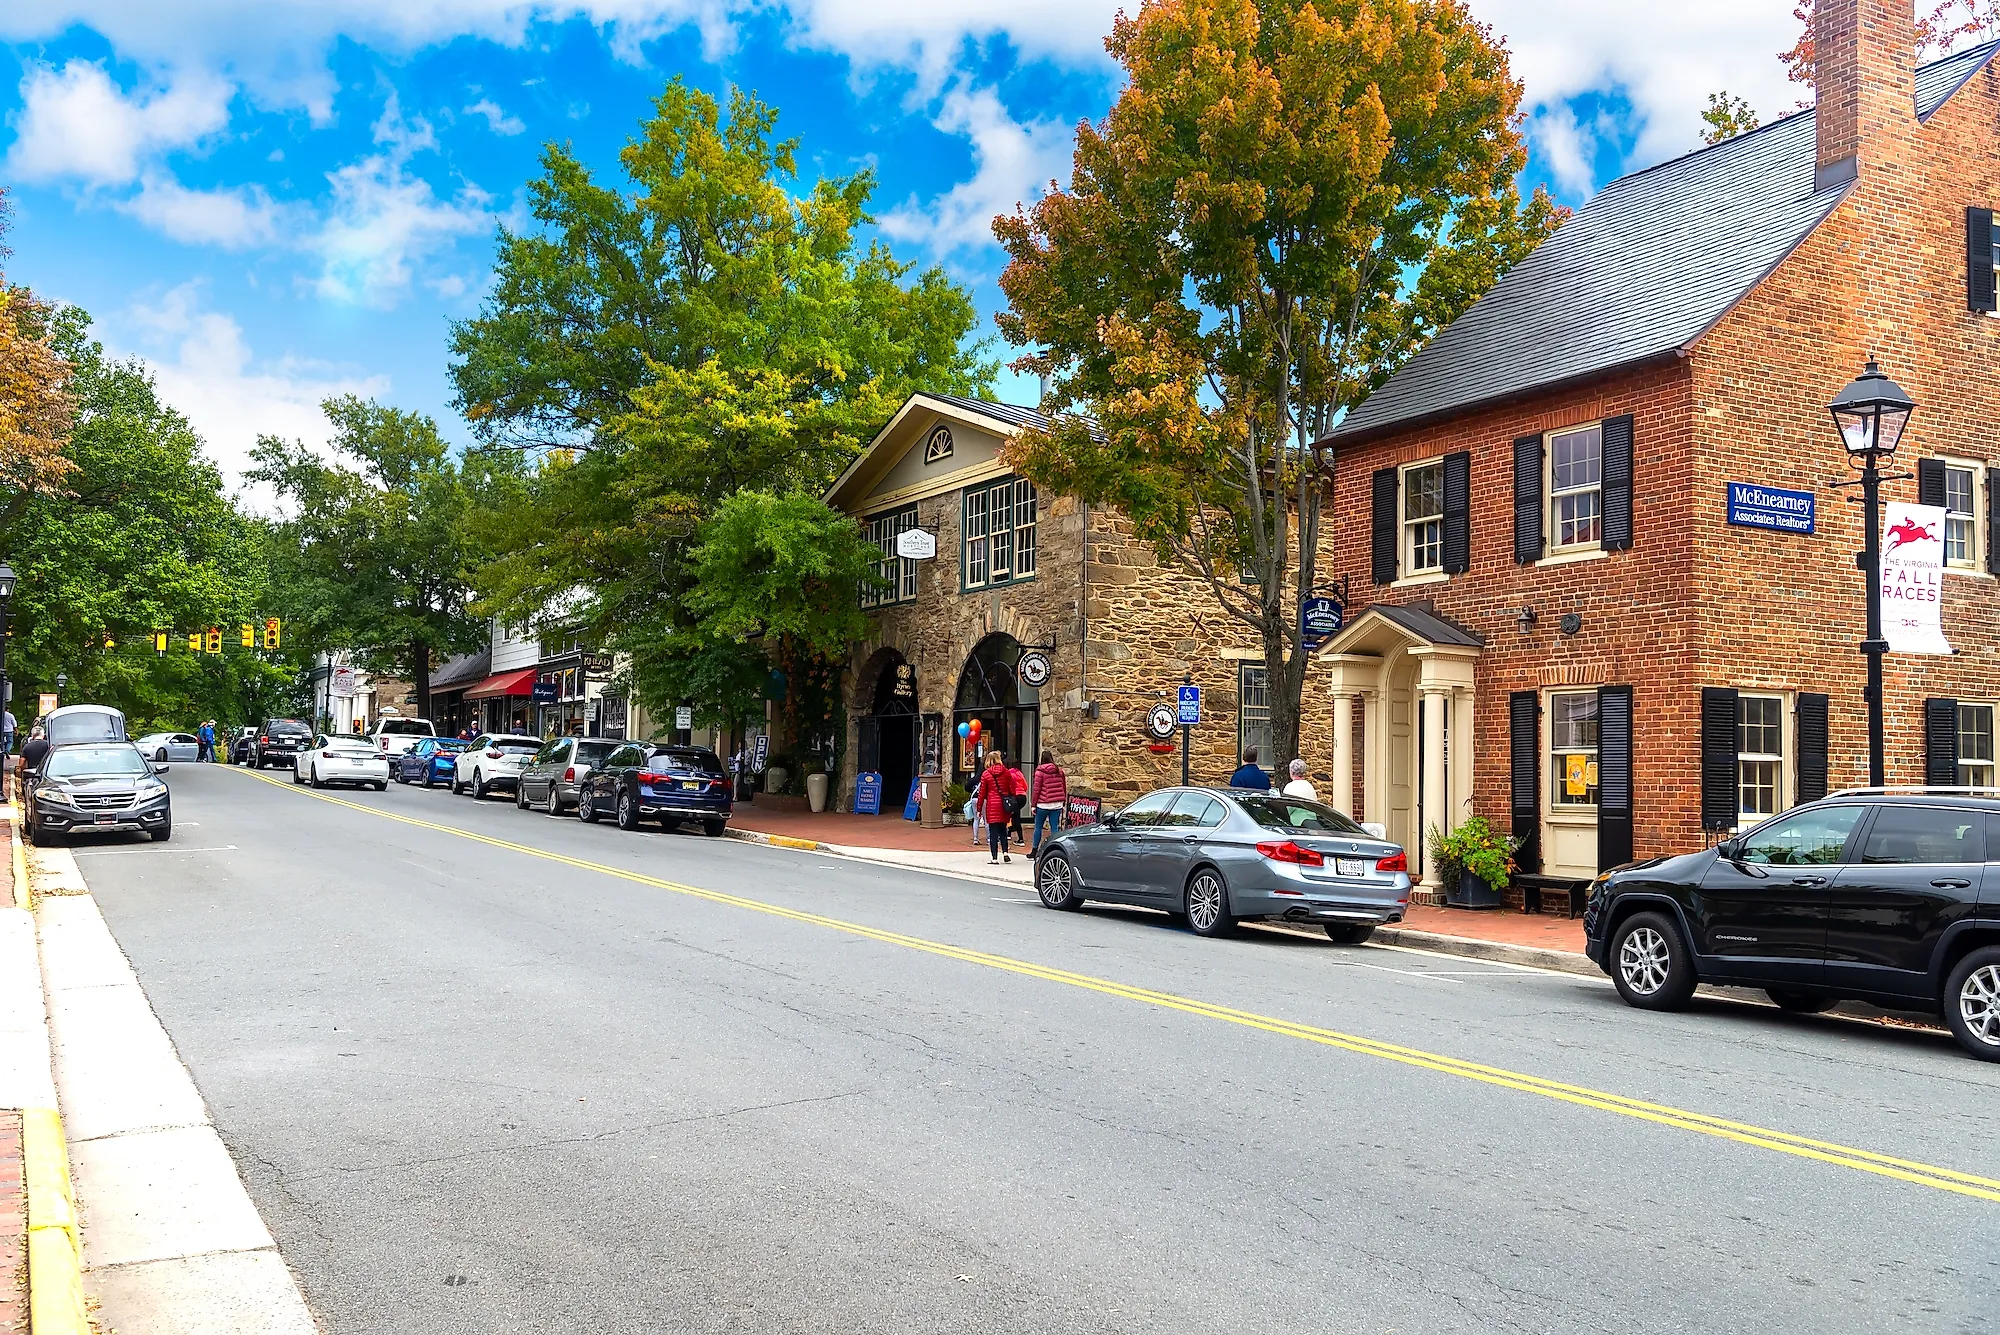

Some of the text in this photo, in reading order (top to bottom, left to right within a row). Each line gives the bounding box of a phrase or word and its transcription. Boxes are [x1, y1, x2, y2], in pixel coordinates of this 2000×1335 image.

[1734, 486, 1811, 515] McEnearney
[1734, 509, 1775, 525] Associates
[1884, 558, 1939, 569] THE VIRGINIA
[1883, 568, 1937, 586] FALL
[1882, 585, 1937, 602] RACES
[1306, 611, 1340, 623] McEnearney
[754, 737, 767, 770] OPEN
